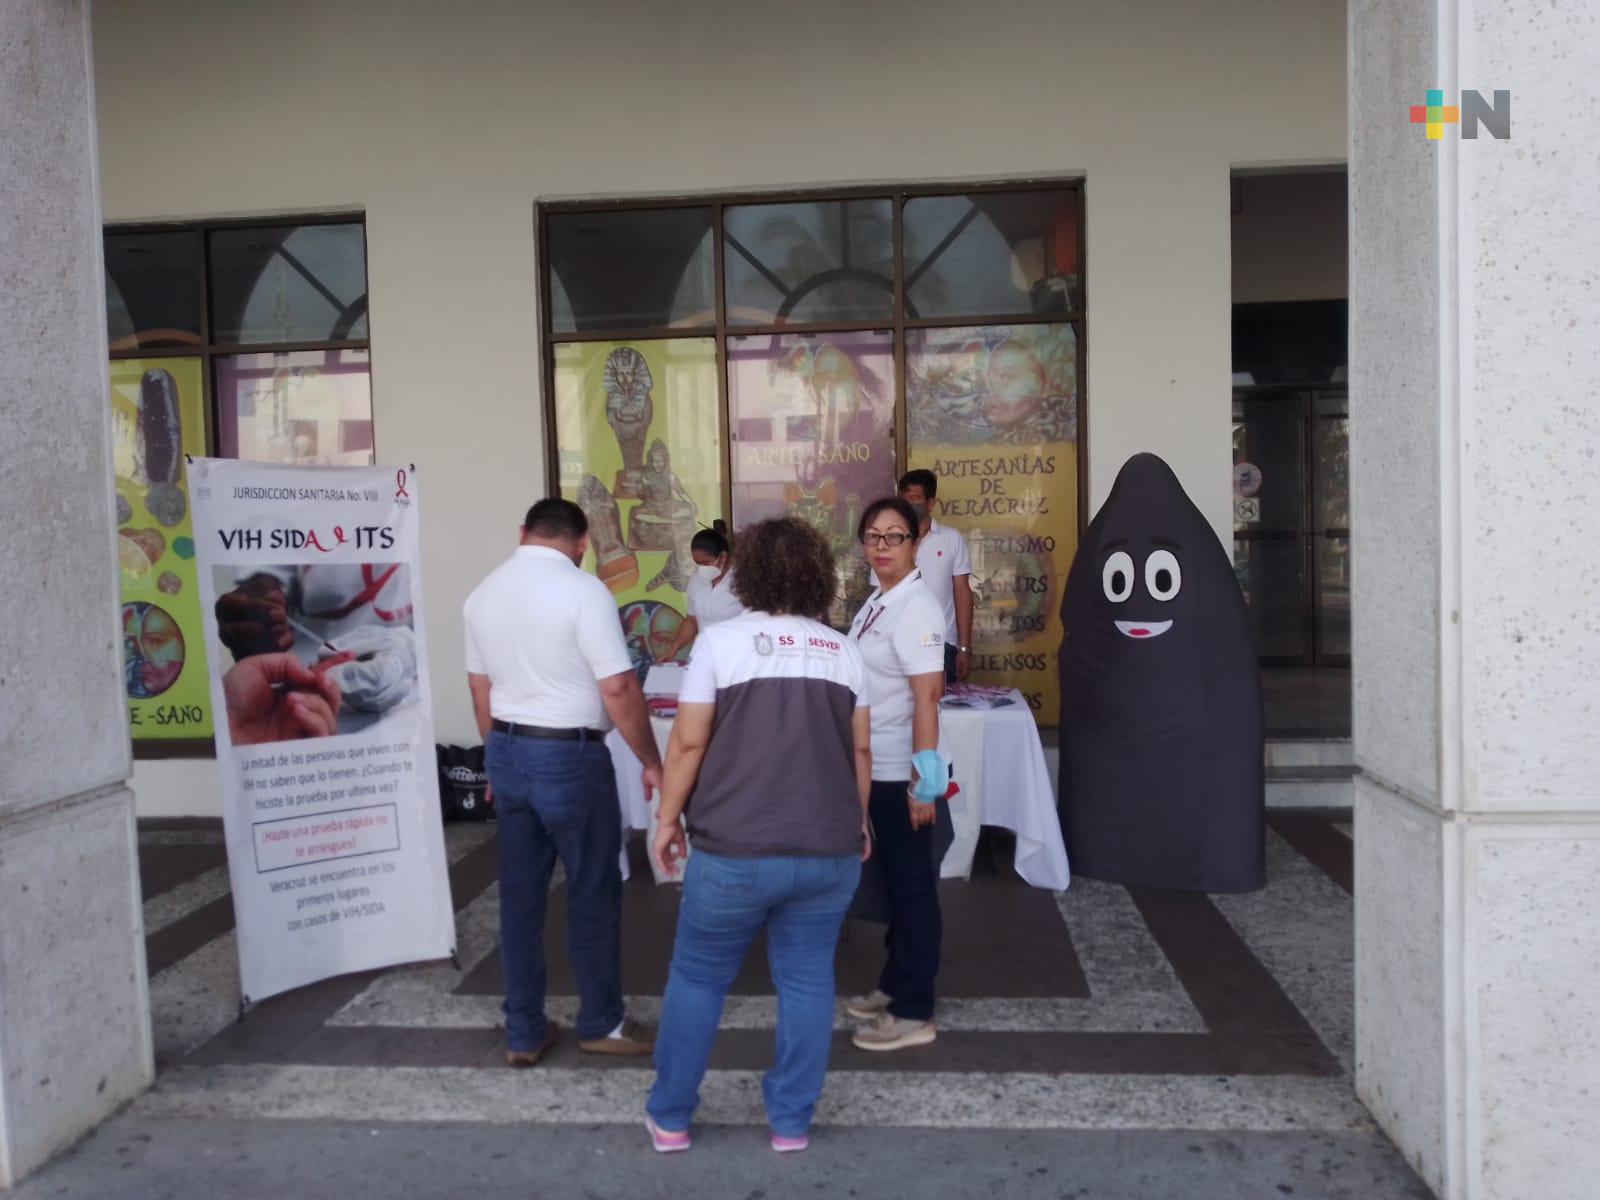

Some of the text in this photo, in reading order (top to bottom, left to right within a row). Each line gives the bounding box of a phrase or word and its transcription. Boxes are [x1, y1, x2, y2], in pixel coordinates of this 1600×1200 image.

[932, 454, 1055, 477] ARTESANÍAS
[233, 486, 296, 500] JURISDICCION
[298, 488, 345, 501] SANITARIA
[363, 490, 379, 501] VIII
[980, 478, 1006, 496] DE
[937, 497, 1049, 517] VERACRUZ
[218, 528, 262, 550] VIH
[270, 528, 333, 552] SIDA
[354, 525, 395, 549] ITS
[778, 635, 840, 651] SS SESVER
[251, 754, 275, 769] mitad
[277, 753, 289, 766] de
[291, 752, 304, 765] las
[306, 748, 346, 765] personas
[348, 748, 365, 760] que
[367, 744, 390, 757] viven
[393, 742, 410, 752] con
[256, 778, 267, 790] no
[269, 773, 296, 787] saben
[298, 772, 315, 786] que
[318, 769, 327, 782] lo
[328, 766, 359, 780] tienen.
[404, 760, 413, 771] te
[256, 796, 284, 810] hiciste
[286, 793, 295, 806] la
[296, 789, 328, 806] prueba
[330, 788, 346, 802] por
[379, 780, 399, 793] vez?
[291, 825, 309, 839] una
[311, 820, 343, 838] prueba
[375, 815, 388, 826] no
[295, 846, 305, 858] te
[269, 862, 396, 893] Veracruz se encuentra en los
[296, 886, 370, 911] primeros lugares
[287, 920, 303, 932] con
[303, 914, 328, 928] casos
[328, 910, 340, 921] de
